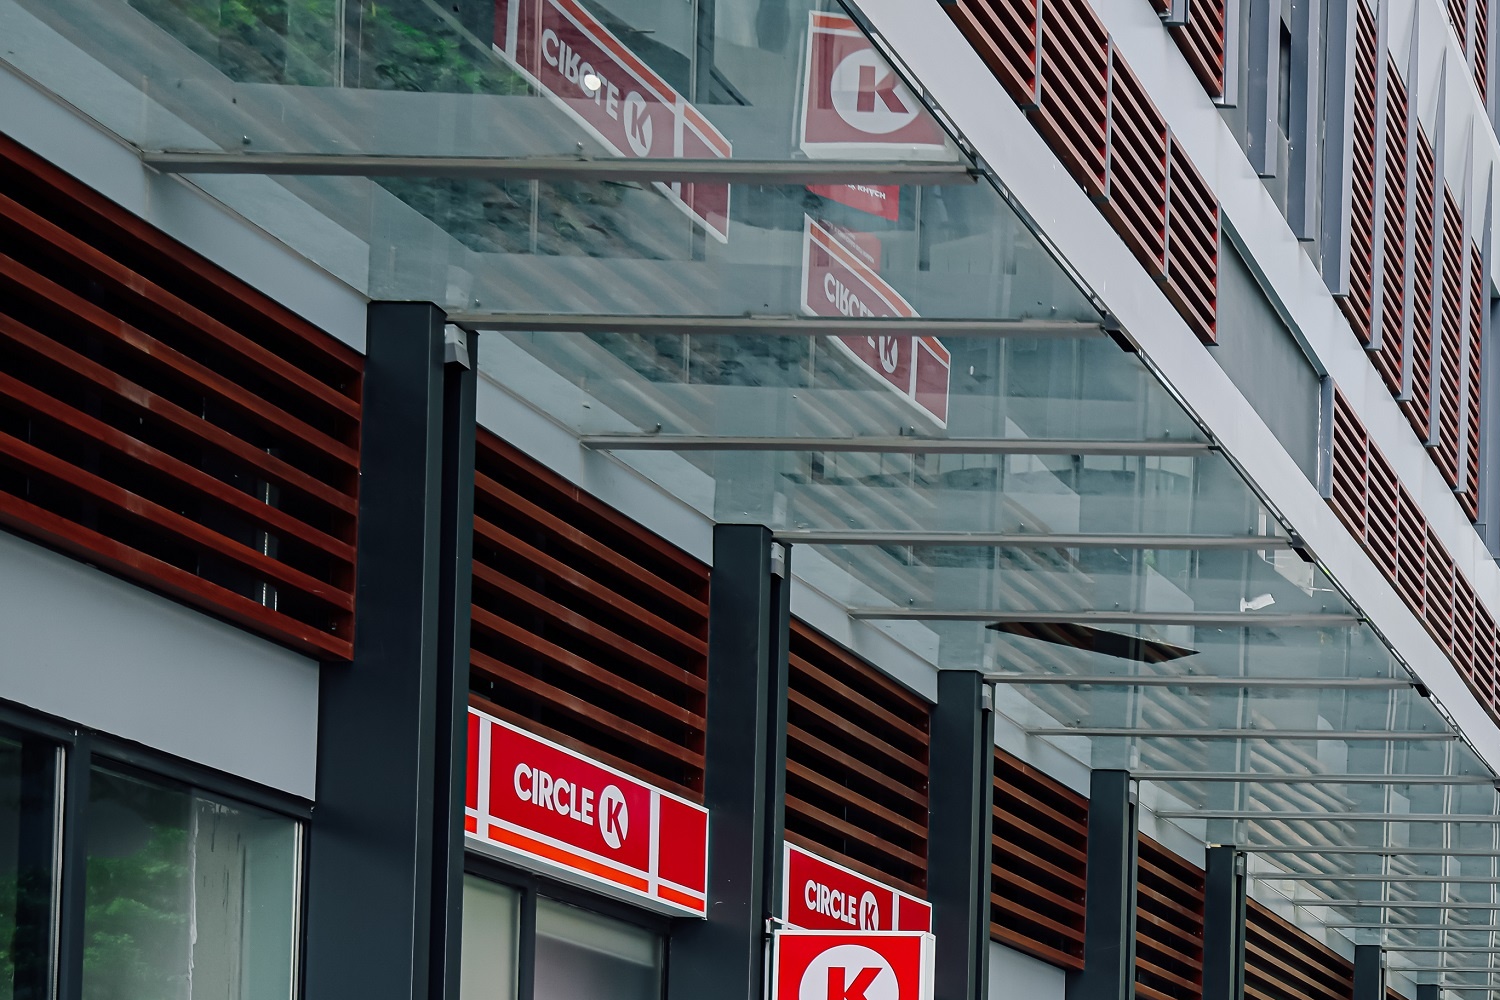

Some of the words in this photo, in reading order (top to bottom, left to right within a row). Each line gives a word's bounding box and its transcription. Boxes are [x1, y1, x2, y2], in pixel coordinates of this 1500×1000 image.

[514, 763, 593, 825] CIRCLE
[604, 793, 628, 848] K
[804, 879, 857, 926] CIRCLE
[862, 896, 879, 930] K
